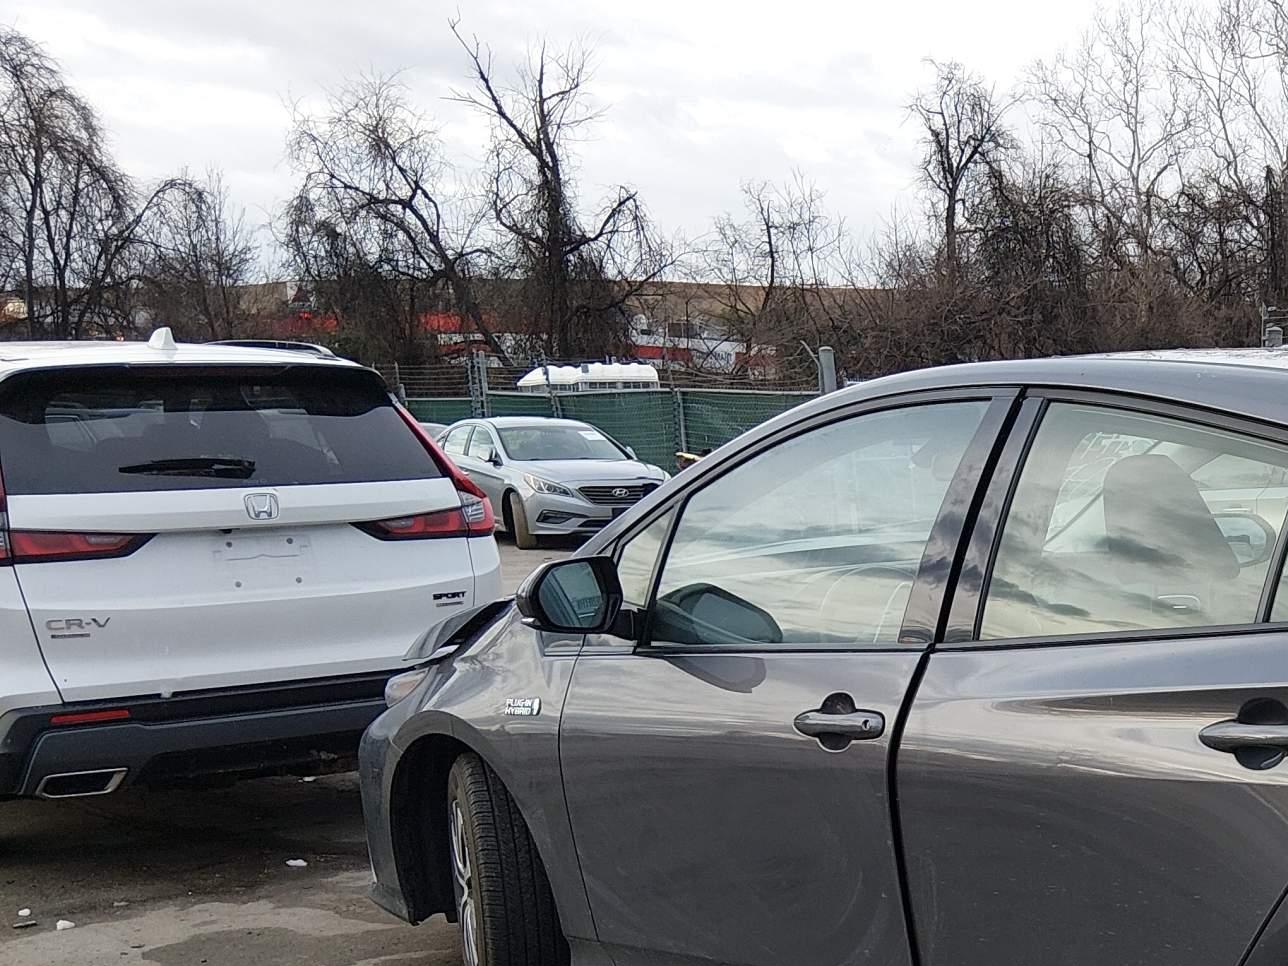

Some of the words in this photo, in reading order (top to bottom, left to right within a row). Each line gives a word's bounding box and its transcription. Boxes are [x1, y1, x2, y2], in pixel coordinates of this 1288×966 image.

[432, 591, 467, 600] SPORT
[46, 616, 111, 630] CR-V
[504, 706, 531, 716] HYBRID
